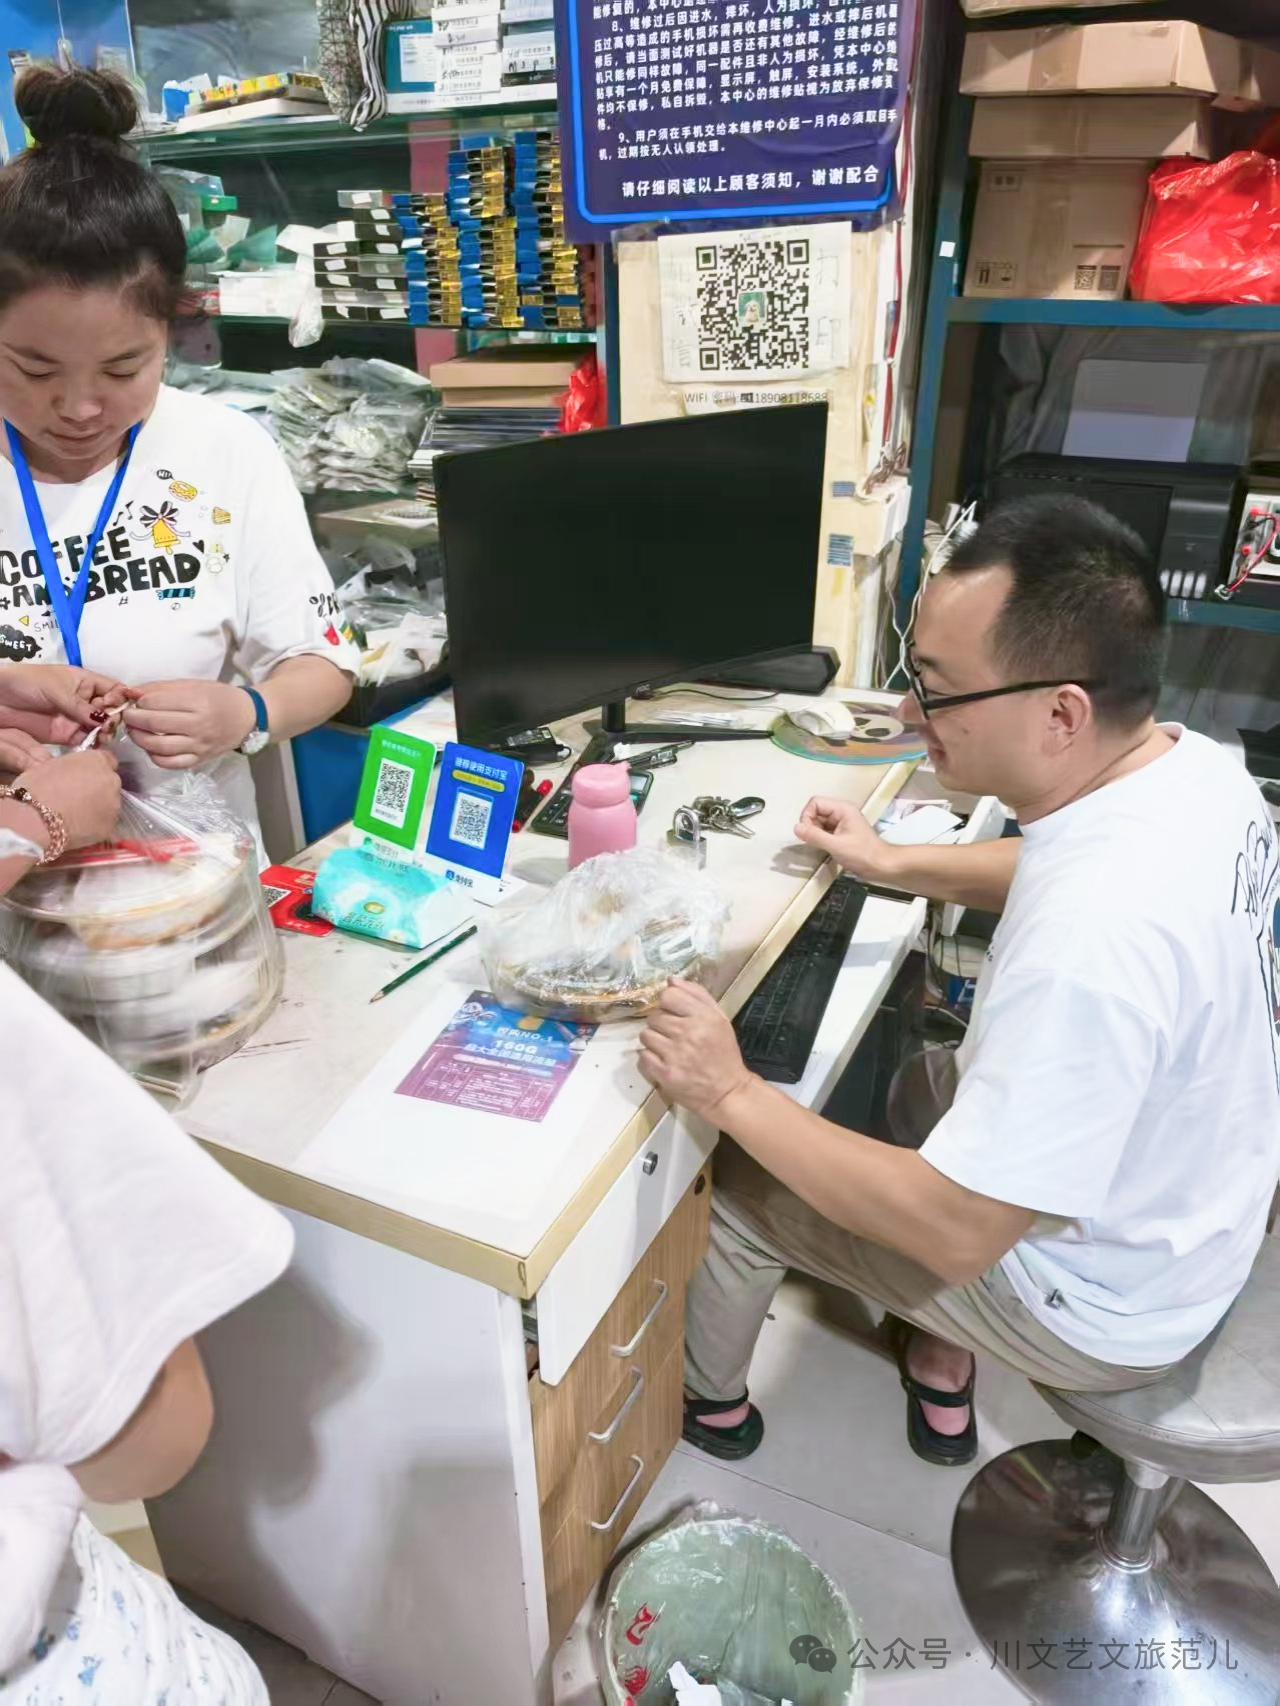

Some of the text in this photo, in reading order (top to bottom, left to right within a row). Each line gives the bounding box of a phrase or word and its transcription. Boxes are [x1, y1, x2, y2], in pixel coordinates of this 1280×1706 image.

[598, 139, 726, 161] 机，过期按无人认领处理。
[622, 164, 880, 197] 请仔细阅读以上顾客须知，谢谢配合
[0, 526, 131, 586] COFEE
[13, 553, 202, 609] AN BREAD
[0, 633, 33, 652] SWEET
